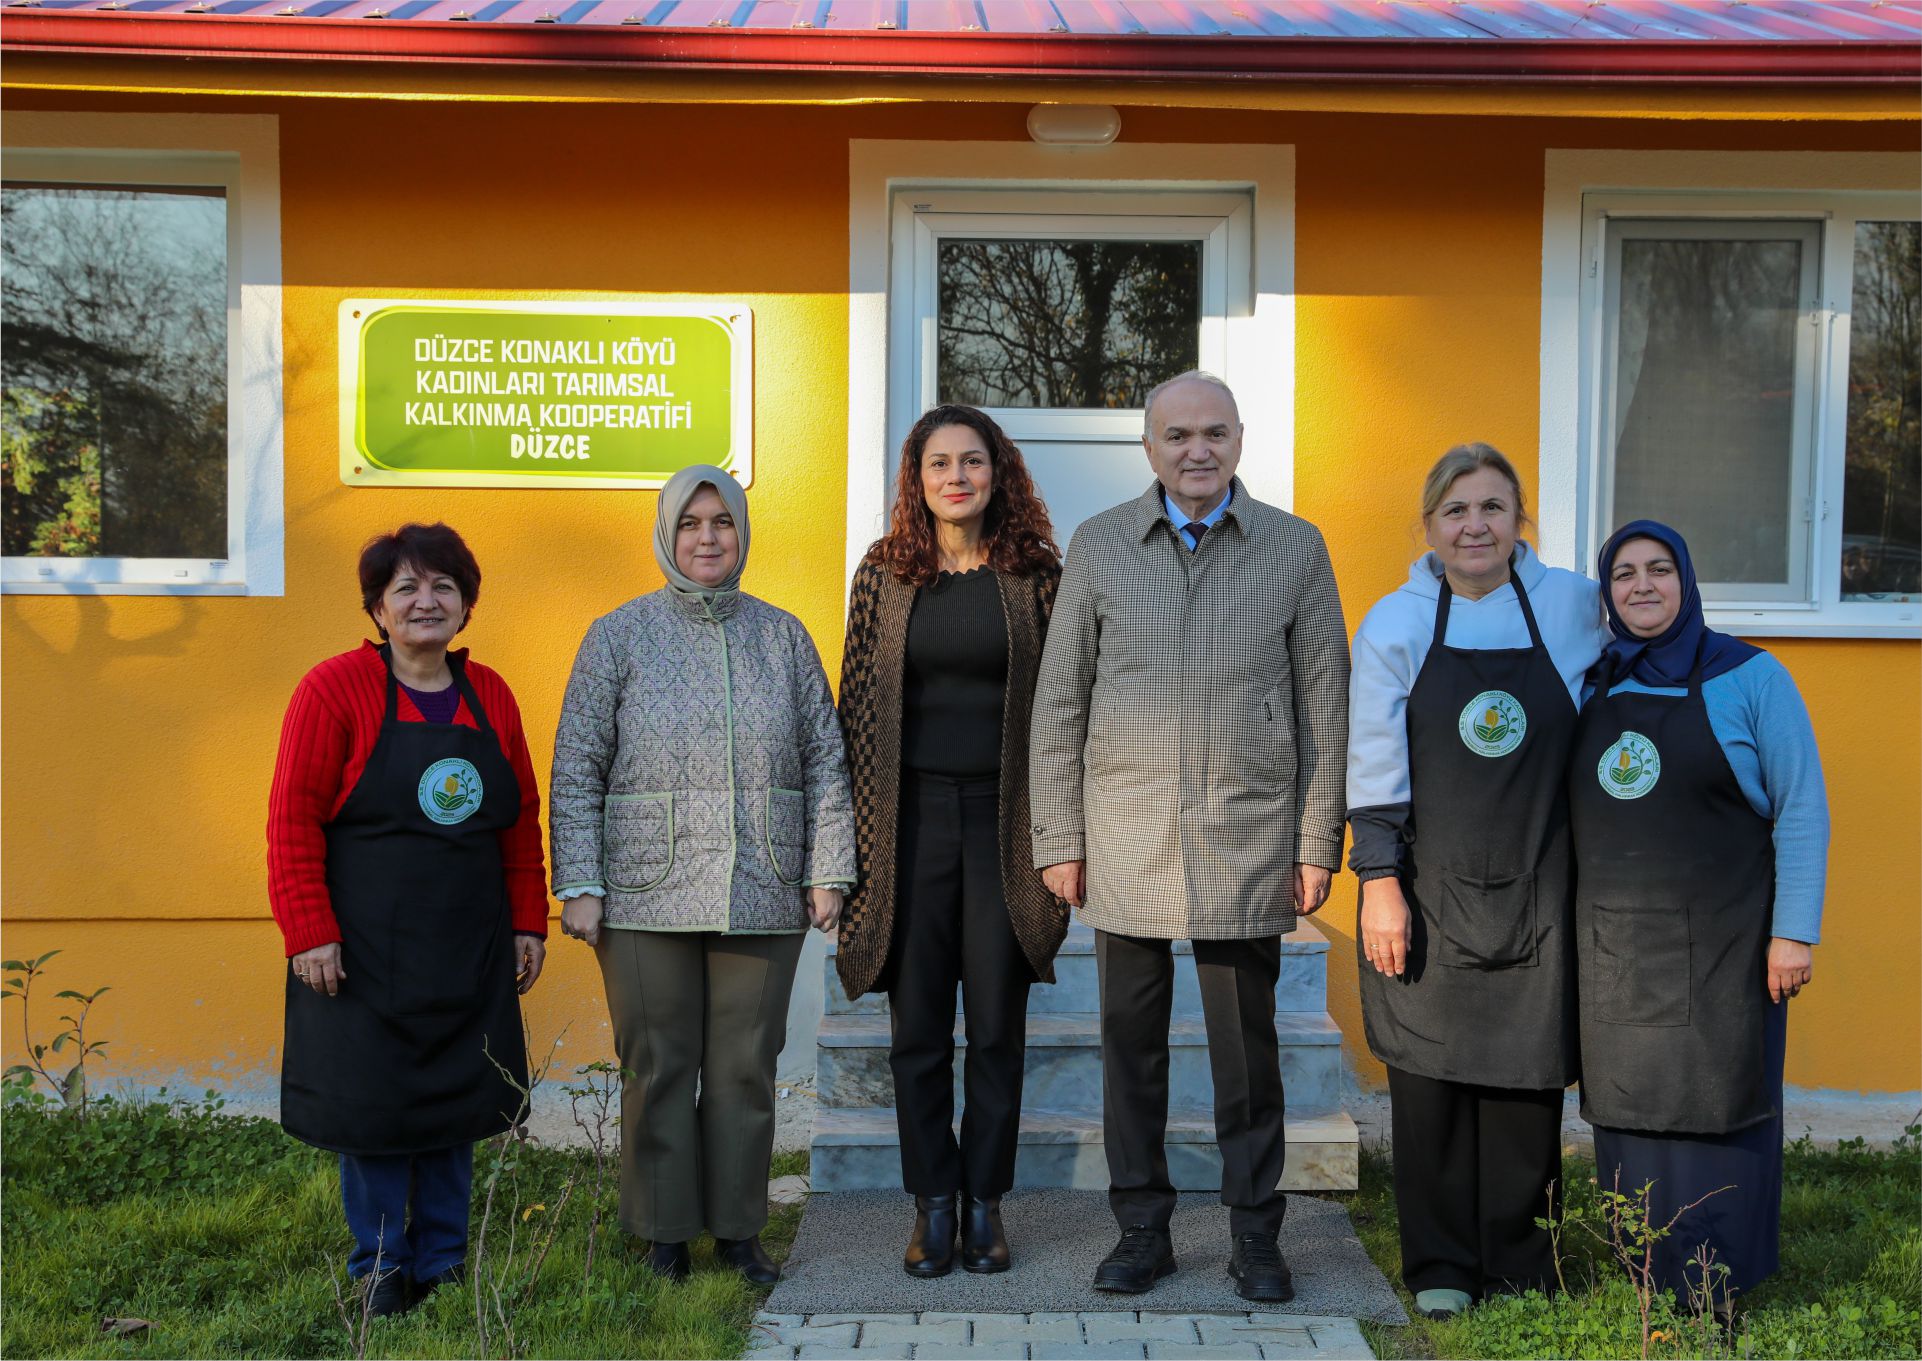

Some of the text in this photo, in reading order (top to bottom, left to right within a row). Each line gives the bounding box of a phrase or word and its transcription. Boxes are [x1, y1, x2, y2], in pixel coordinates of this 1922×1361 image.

[416, 335, 675, 365] DÜZCE KONAKLI KÖYÜ
[417, 371, 674, 397] KADINLARI TARIMSAL
[406, 401, 692, 429] KALKINMA KOOPERATİFİ
[510, 427, 590, 459] DÜZCE
